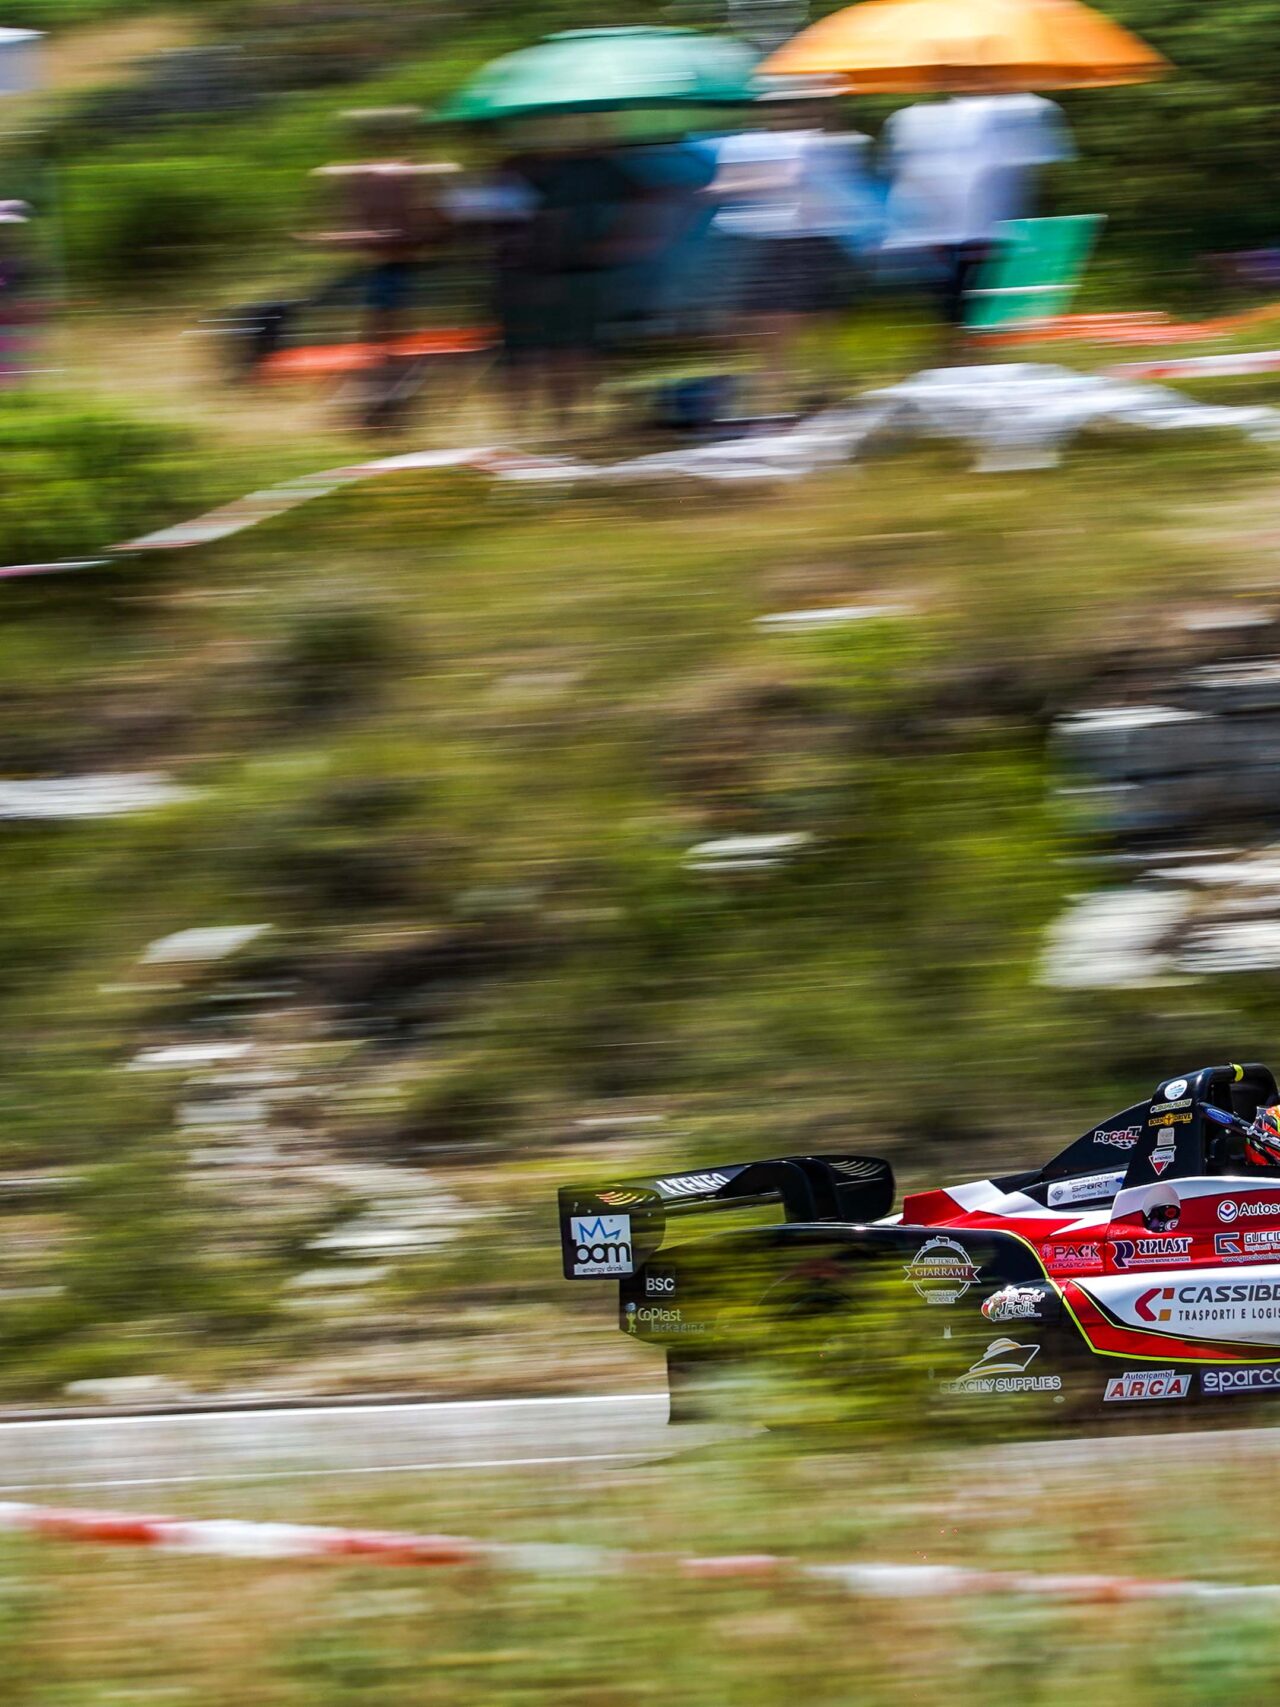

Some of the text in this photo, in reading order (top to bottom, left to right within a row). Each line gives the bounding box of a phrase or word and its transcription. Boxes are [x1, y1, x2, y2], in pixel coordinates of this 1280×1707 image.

[1071, 1181, 1110, 1192] SPORT
[915, 1266, 969, 1276] GIARRAMI
[646, 1278, 675, 1291] BSC
[637, 1308, 682, 1321] CoPlast
[1179, 1309, 1235, 1321] TRASPORTI
[1241, 1308, 1246, 1319] E
[1125, 1371, 1172, 1380] Autoricambi
[996, 1377, 1061, 1391] SUPPLIES
[1110, 1379, 1182, 1397] ARCA
